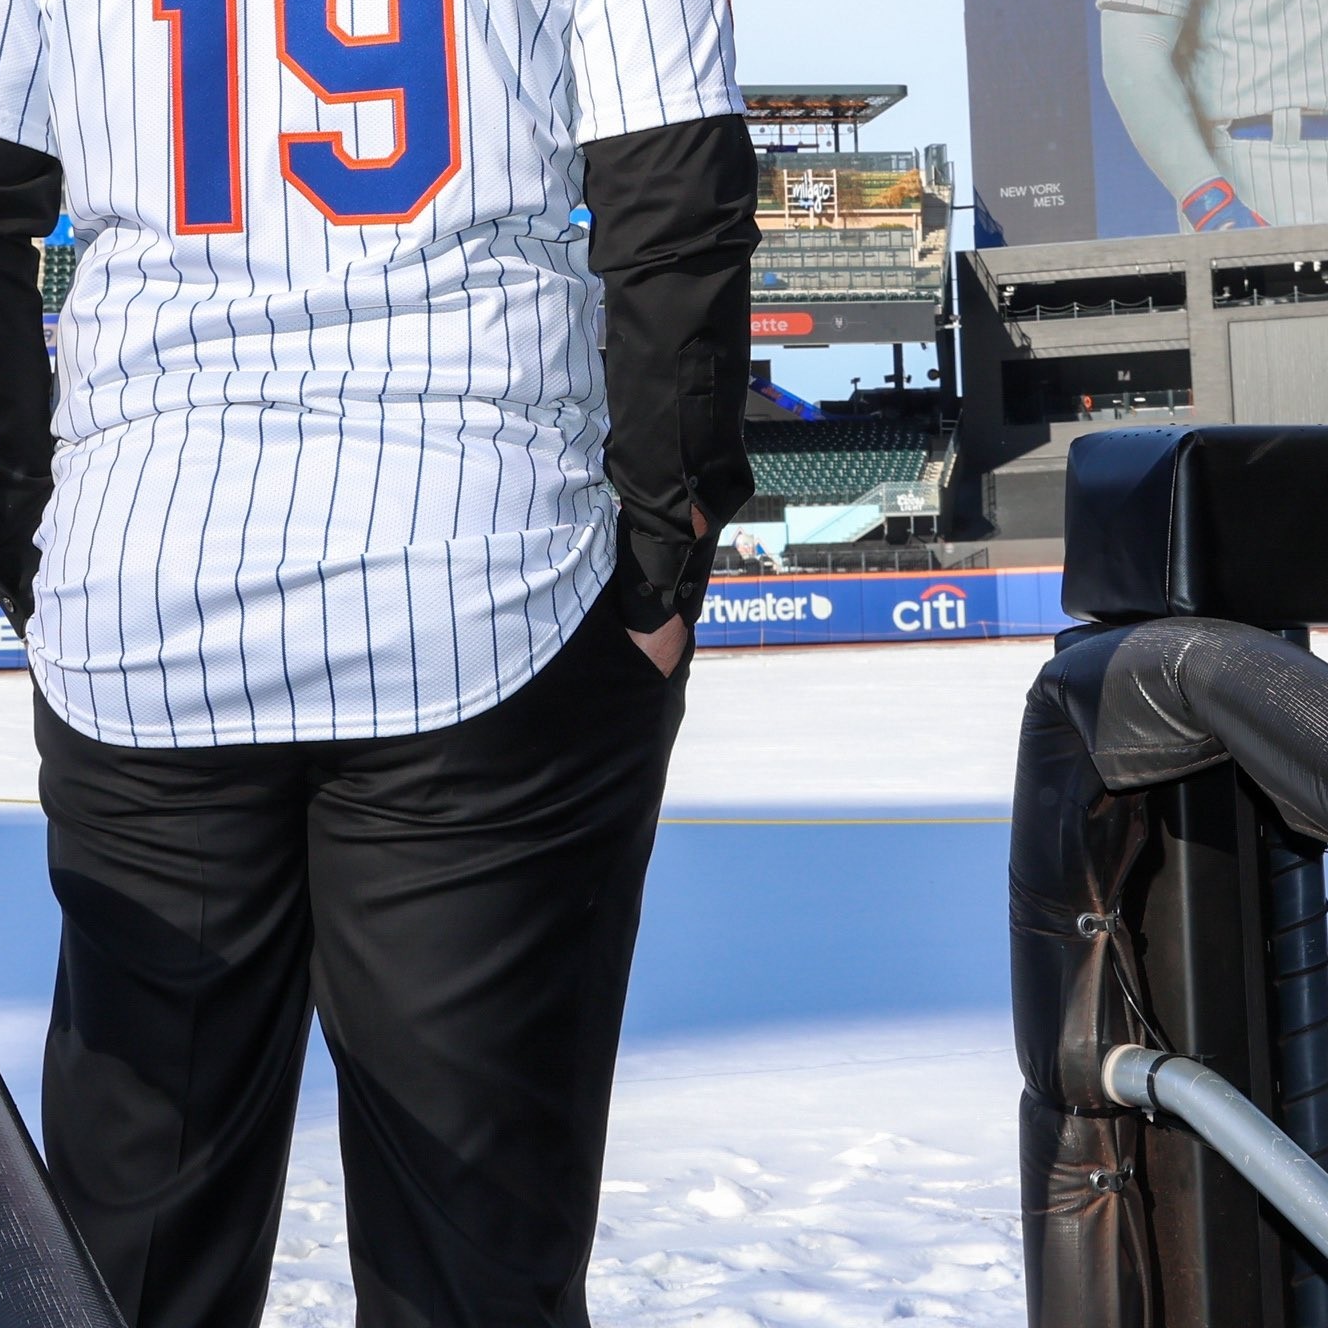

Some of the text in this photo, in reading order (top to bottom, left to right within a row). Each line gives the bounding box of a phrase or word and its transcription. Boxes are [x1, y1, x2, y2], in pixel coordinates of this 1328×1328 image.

[1000, 183, 1061, 198] NEW YORK
[1033, 195, 1065, 208] METS
[751, 318, 789, 332] ette
[892, 591, 967, 632] citi
